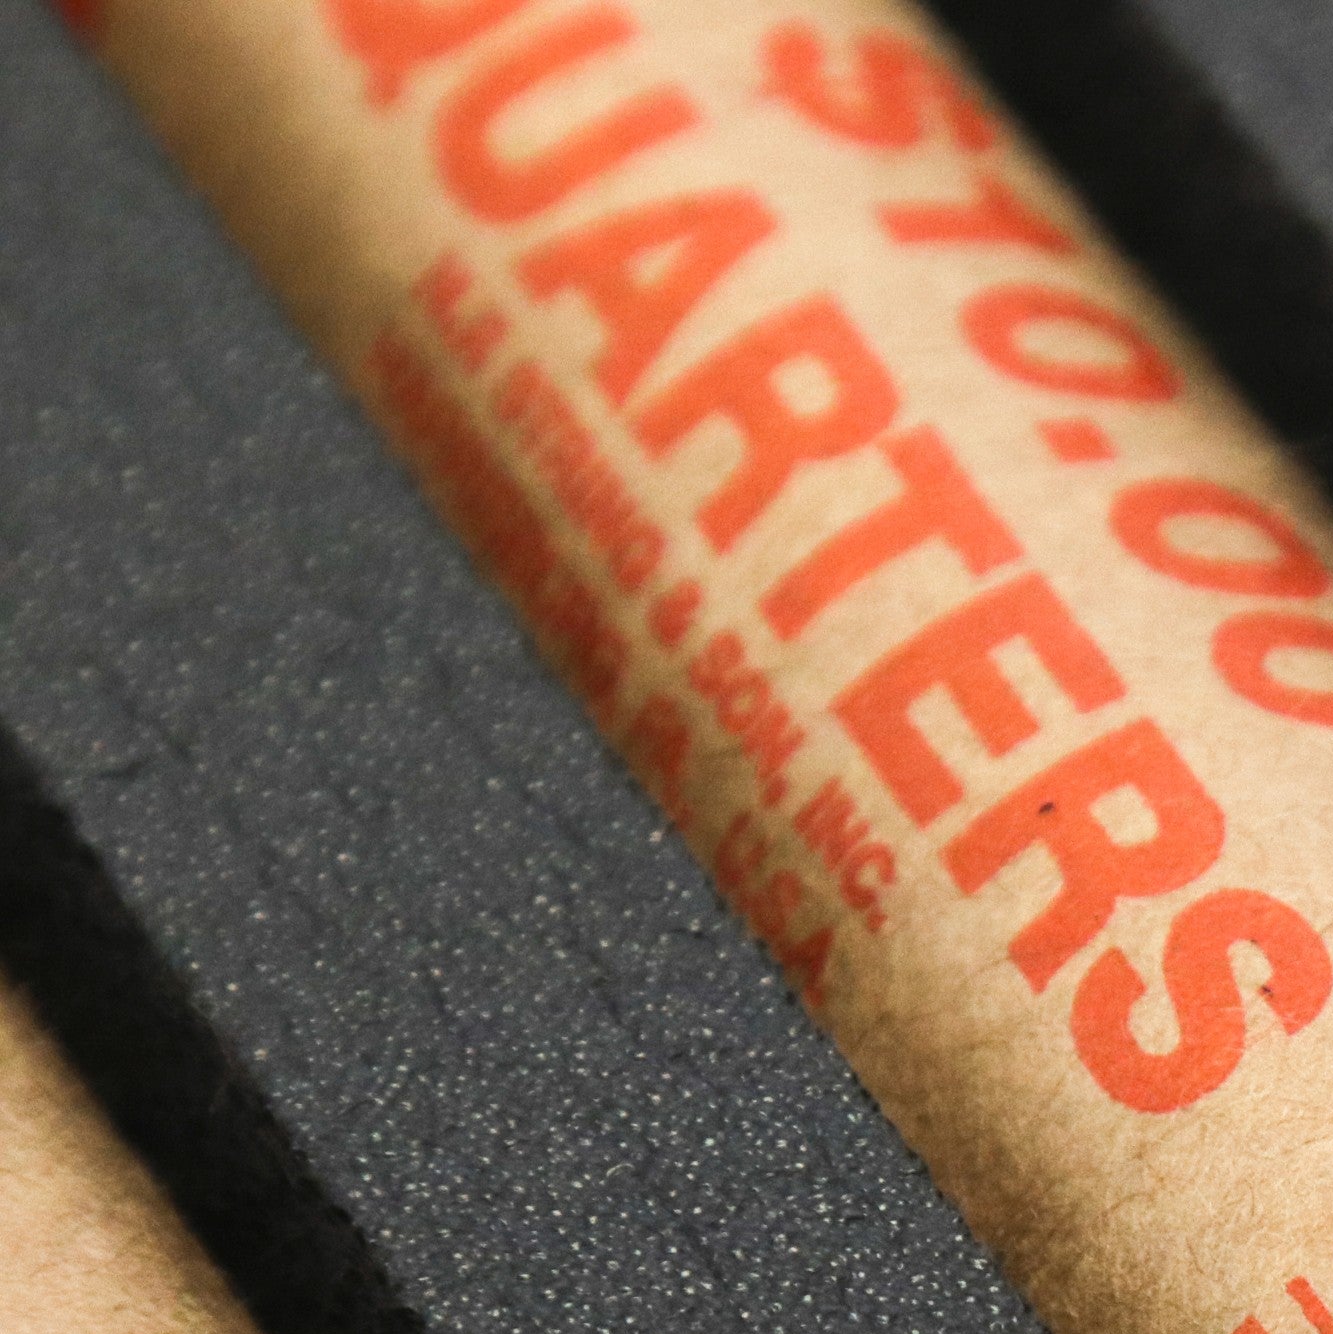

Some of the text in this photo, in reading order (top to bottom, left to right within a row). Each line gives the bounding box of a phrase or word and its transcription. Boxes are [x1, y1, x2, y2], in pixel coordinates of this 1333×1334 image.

[645, 576, 704, 649] &
[688, 627, 808, 810] SON,
[792, 775, 897, 970] INC.
